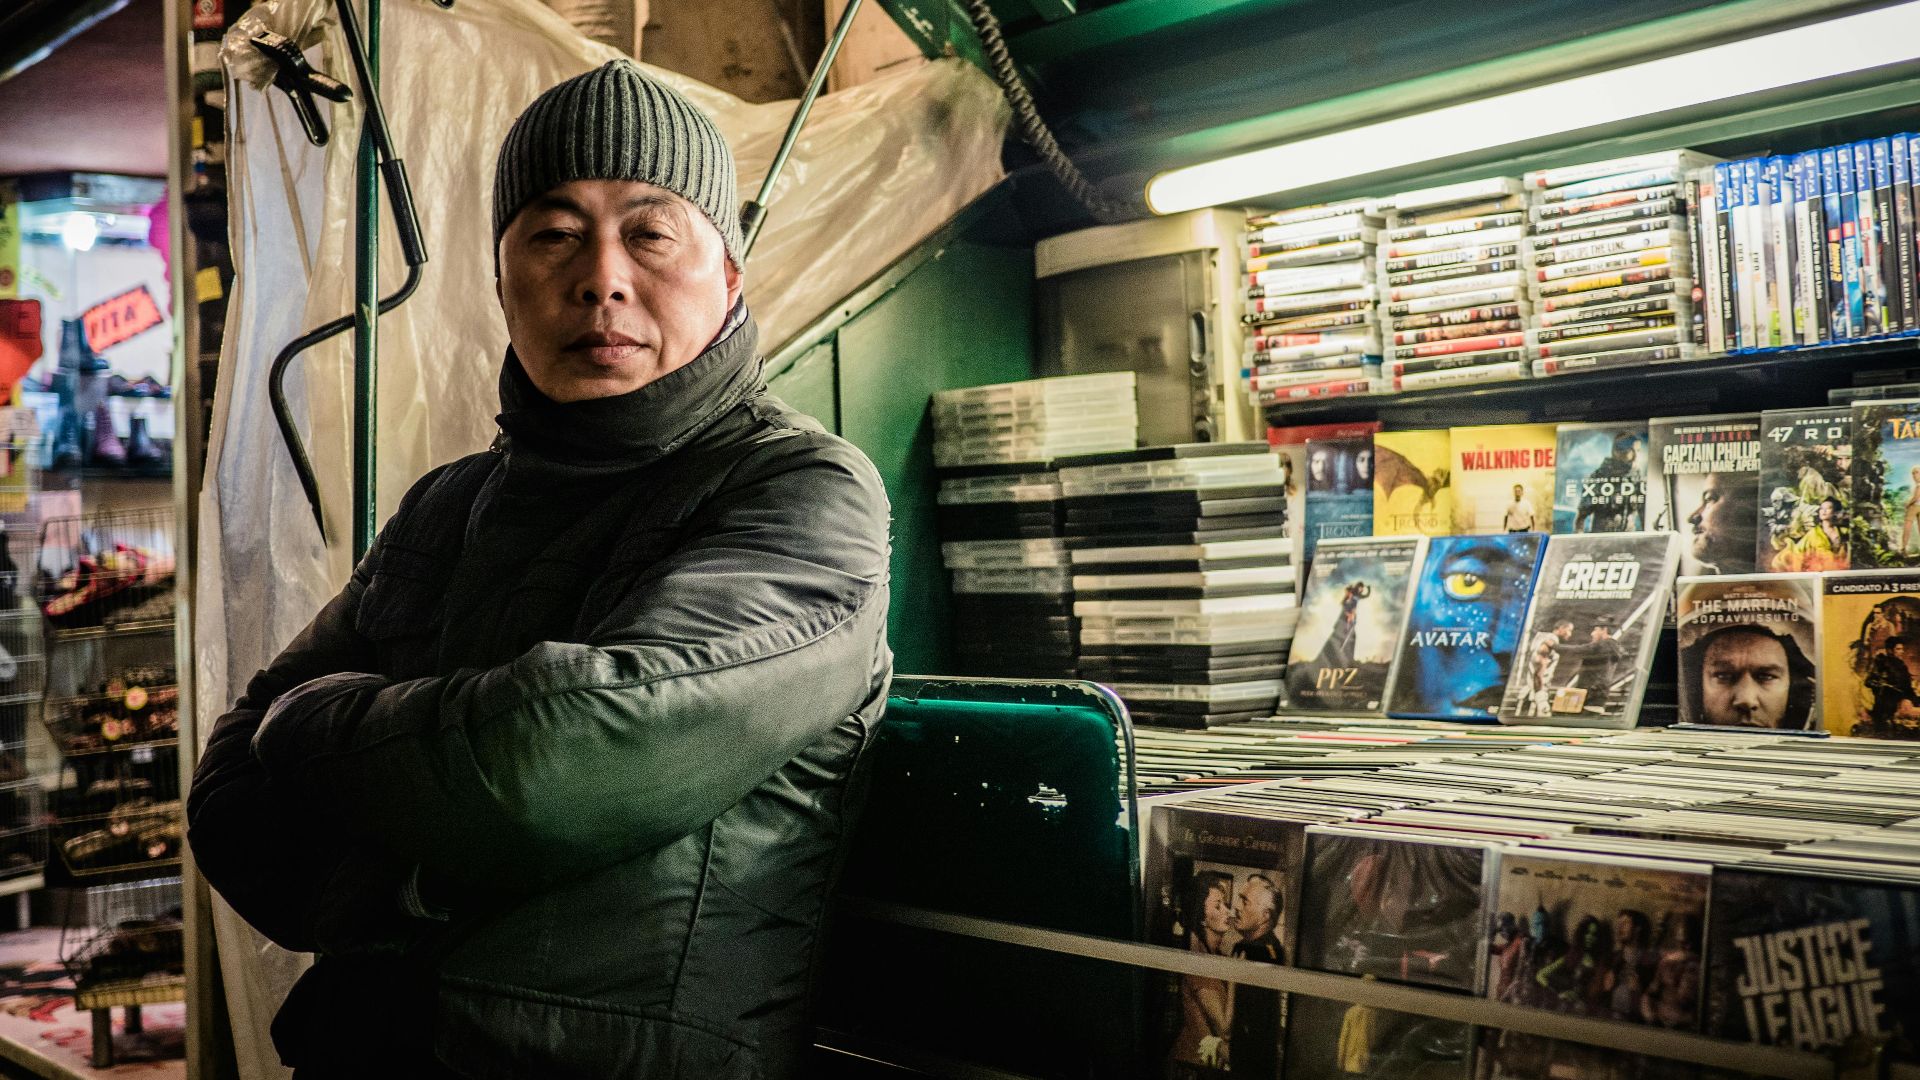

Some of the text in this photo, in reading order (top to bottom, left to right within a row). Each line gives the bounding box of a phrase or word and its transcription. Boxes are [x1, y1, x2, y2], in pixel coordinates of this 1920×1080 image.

[1767, 427, 1793, 442] 47
[1462, 448, 1556, 471] WALKING DE
[1663, 441, 1760, 463] CAPTAIN PHILLIP
[1663, 462, 1699, 474] ATTACCO
[1701, 462, 1710, 473] IN
[1711, 460, 1735, 473] MARE
[1559, 561, 1640, 590] CREED
[1832, 584, 1881, 593] CANDIDATO
[1883, 583, 1890, 592] A
[1892, 582, 1899, 593] 3
[1692, 598, 1798, 613] THE MARTIAN
[1692, 612, 1799, 625] SOPRAVVISSUTO
[1410, 632, 1490, 648] AVATAR
[1315, 668, 1363, 690] PPZ
[1733, 918, 1881, 997] JUSTICE
